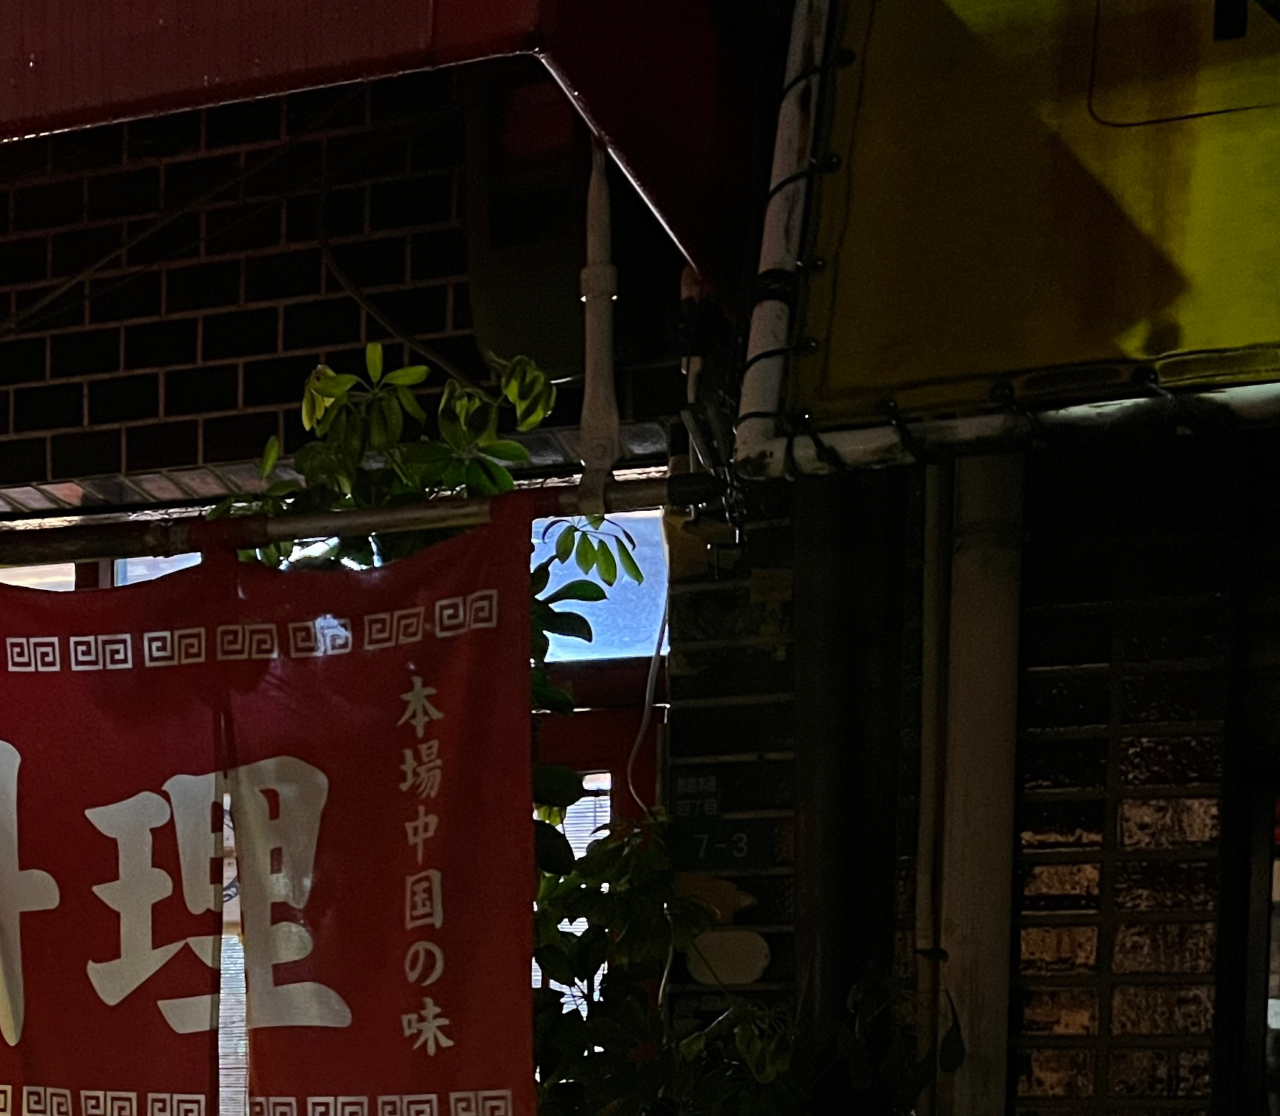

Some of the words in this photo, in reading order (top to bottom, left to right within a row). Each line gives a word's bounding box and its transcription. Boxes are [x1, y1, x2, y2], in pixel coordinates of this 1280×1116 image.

[396, 675, 455, 1057] 本場中国の味
[693, 832, 749, 859] 7-3
